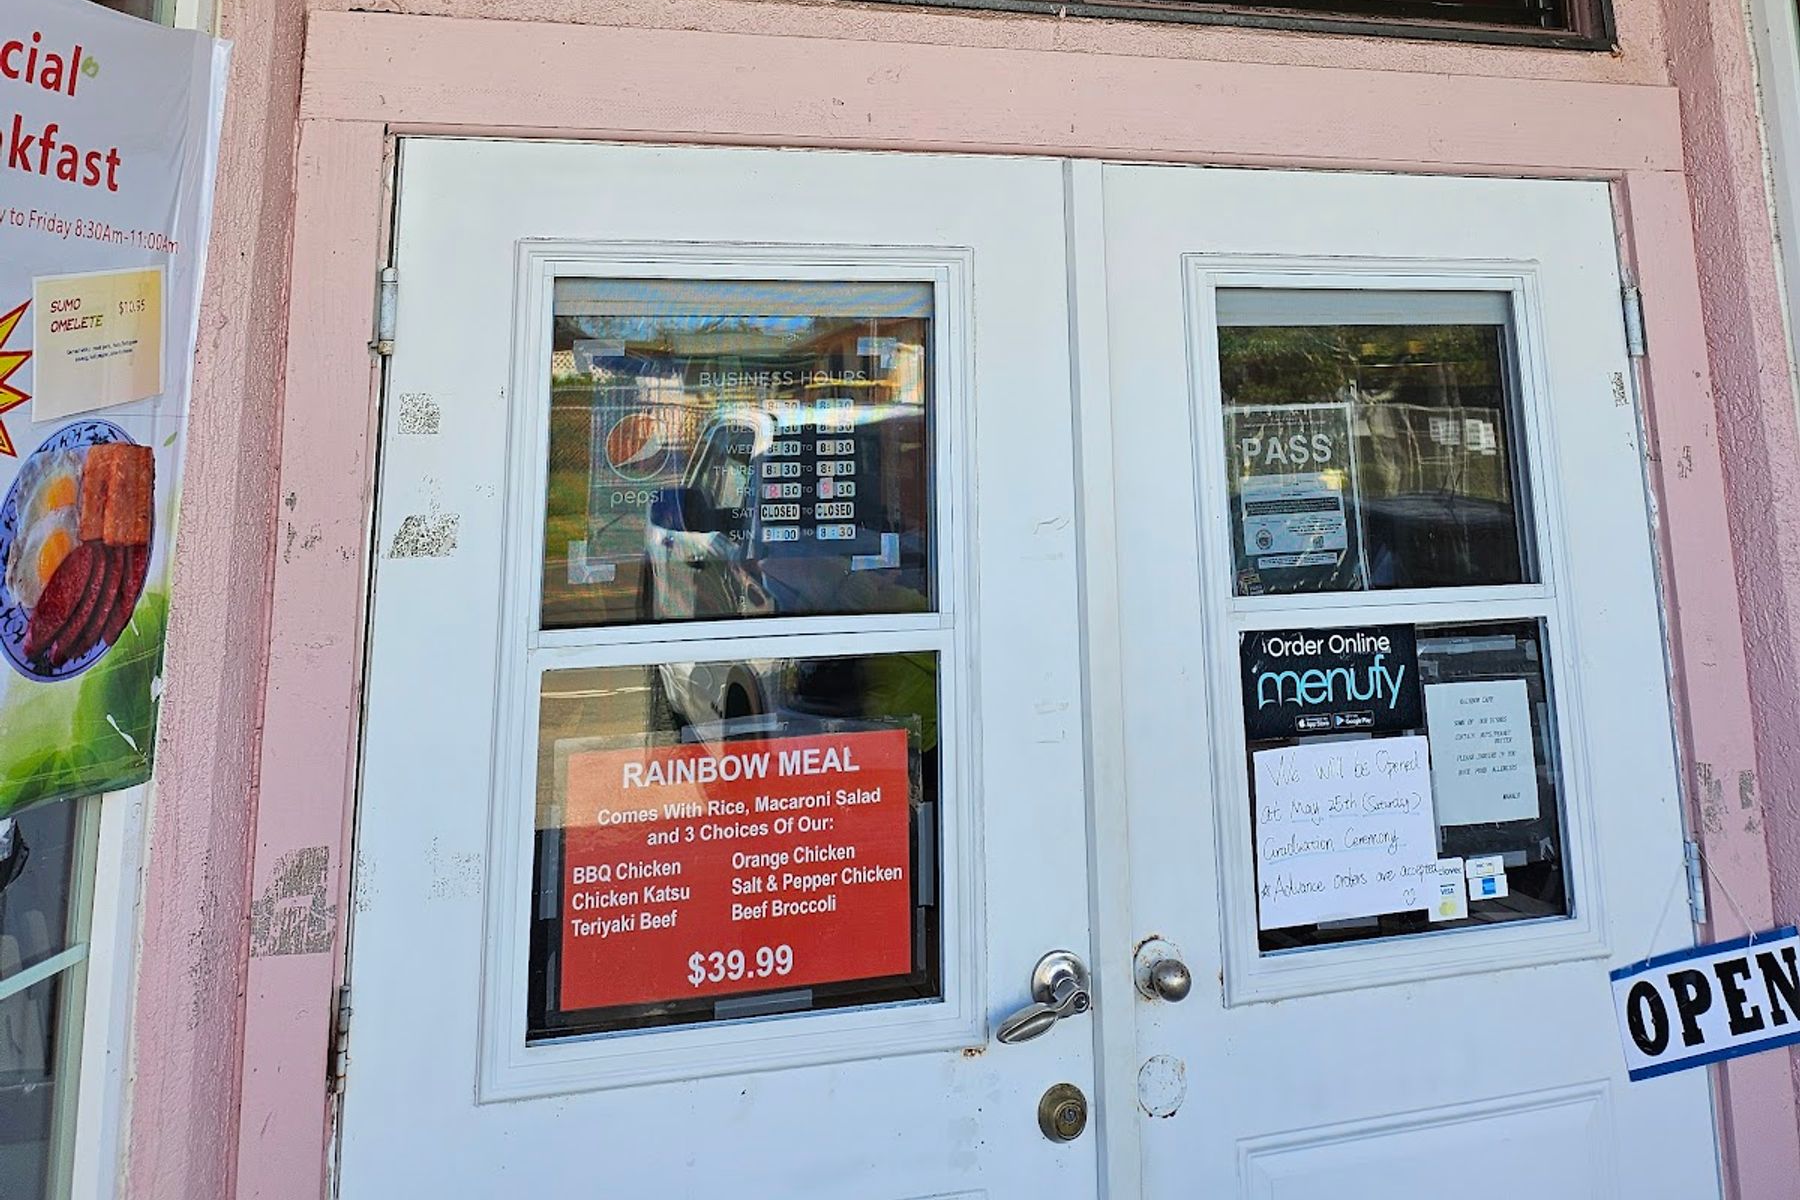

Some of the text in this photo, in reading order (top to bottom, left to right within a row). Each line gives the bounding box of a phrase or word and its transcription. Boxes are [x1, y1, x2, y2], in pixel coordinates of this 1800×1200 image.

[0, 114, 121, 192] kfast
[10, 207, 25, 226] to
[28, 210, 72, 240] Friday
[50, 298, 81, 313] SUMO
[700, 369, 867, 388] BUSINESS HOURS
[1242, 433, 1332, 465] PASS
[610, 487, 664, 508] pepsi
[761, 505, 798, 518] CLOSED
[817, 504, 852, 516] CLOSED
[1267, 633, 1391, 657] Order Online
[1257, 654, 1405, 710] menufy
[623, 747, 860, 788] RAINBOW MEAL
[1315, 756, 1344, 780] will
[598, 787, 881, 827] Comes With Rice, Macaroni Salad
[1291, 800, 1324, 825] May
[647, 814, 834, 846] and 3 Choices Of Our:
[732, 843, 855, 872] Orange Chicken
[573, 860, 681, 885] BBQ Chicken
[732, 865, 903, 896] Salt & Pepper Chicken
[572, 884, 690, 910] Chicken Katsu
[1440, 887, 1454, 895] VISA
[732, 895, 836, 921] Beef Broccoli
[572, 910, 677, 938] Teriyaki Beef
[687, 943, 794, 987] $39.99
[1627, 946, 1800, 1057] OPEN
